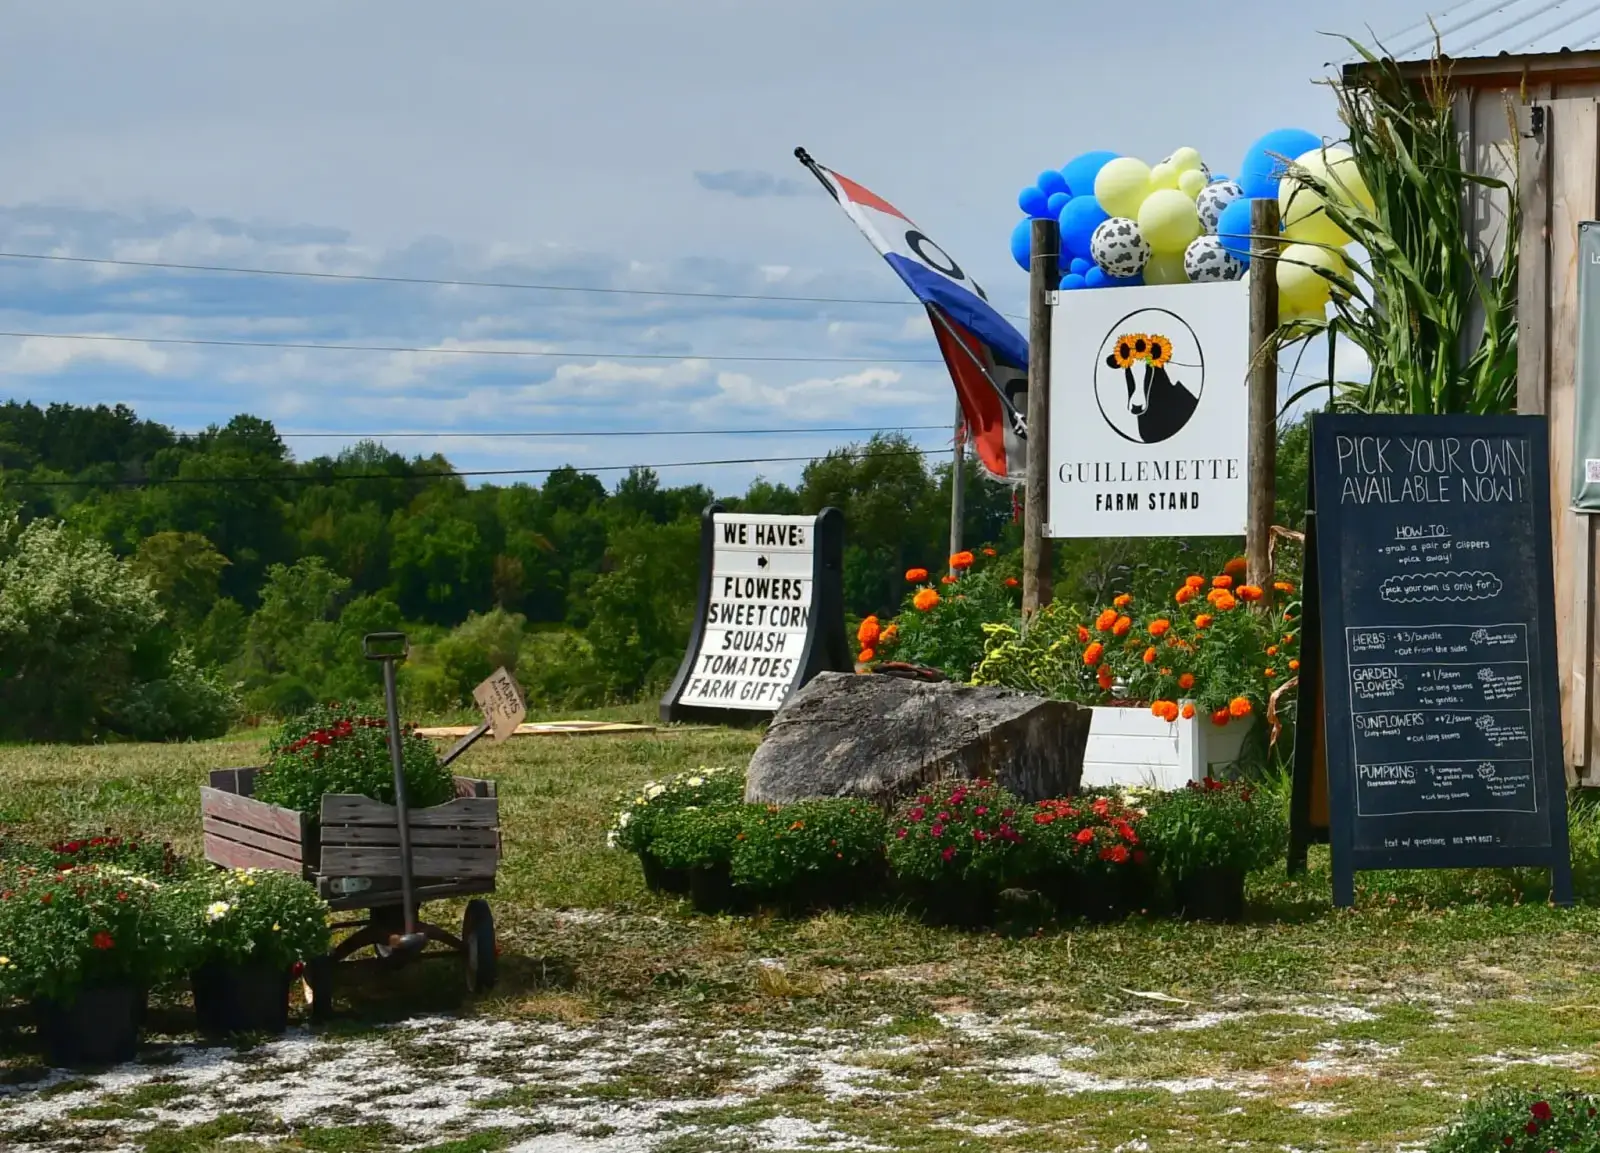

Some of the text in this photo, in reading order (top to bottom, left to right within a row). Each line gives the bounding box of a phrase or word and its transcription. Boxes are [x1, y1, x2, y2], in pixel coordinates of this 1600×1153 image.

[1336, 434, 1526, 476] PICK YOUR OWN
[1058, 458, 1240, 484] GUILLEMETTE
[1341, 475, 1524, 505] AVAILABLE NOW!
[1096, 491, 1200, 511] FARM STAND
[723, 523, 805, 546] WE HAVE:
[1385, 544, 1406, 554] grab
[1421, 541, 1439, 553] pair
[1442, 540, 1452, 549] of
[1403, 553, 1452, 566] pick away!
[724, 577, 802, 601] FLOWERS
[1385, 584, 1402, 596] pick
[1404, 585, 1421, 595] your
[1423, 584, 1439, 592] own
[1442, 582, 1450, 591] is
[1454, 580, 1473, 592] only
[707, 602, 809, 628] SWEET CORN
[721, 630, 787, 653] SQUASH
[1414, 645, 1433, 654] from
[1435, 644, 1448, 653] the
[702, 655, 792, 680] TOMATOES
[1353, 666, 1398, 681] GARDEN
[687, 678, 792, 703] FARM GIFTS
[1354, 679, 1405, 693] FLOWERS
[1355, 712, 1424, 730] SUNFLOWERS
[1426, 733, 1440, 742] long
[1384, 838, 1398, 848] text
